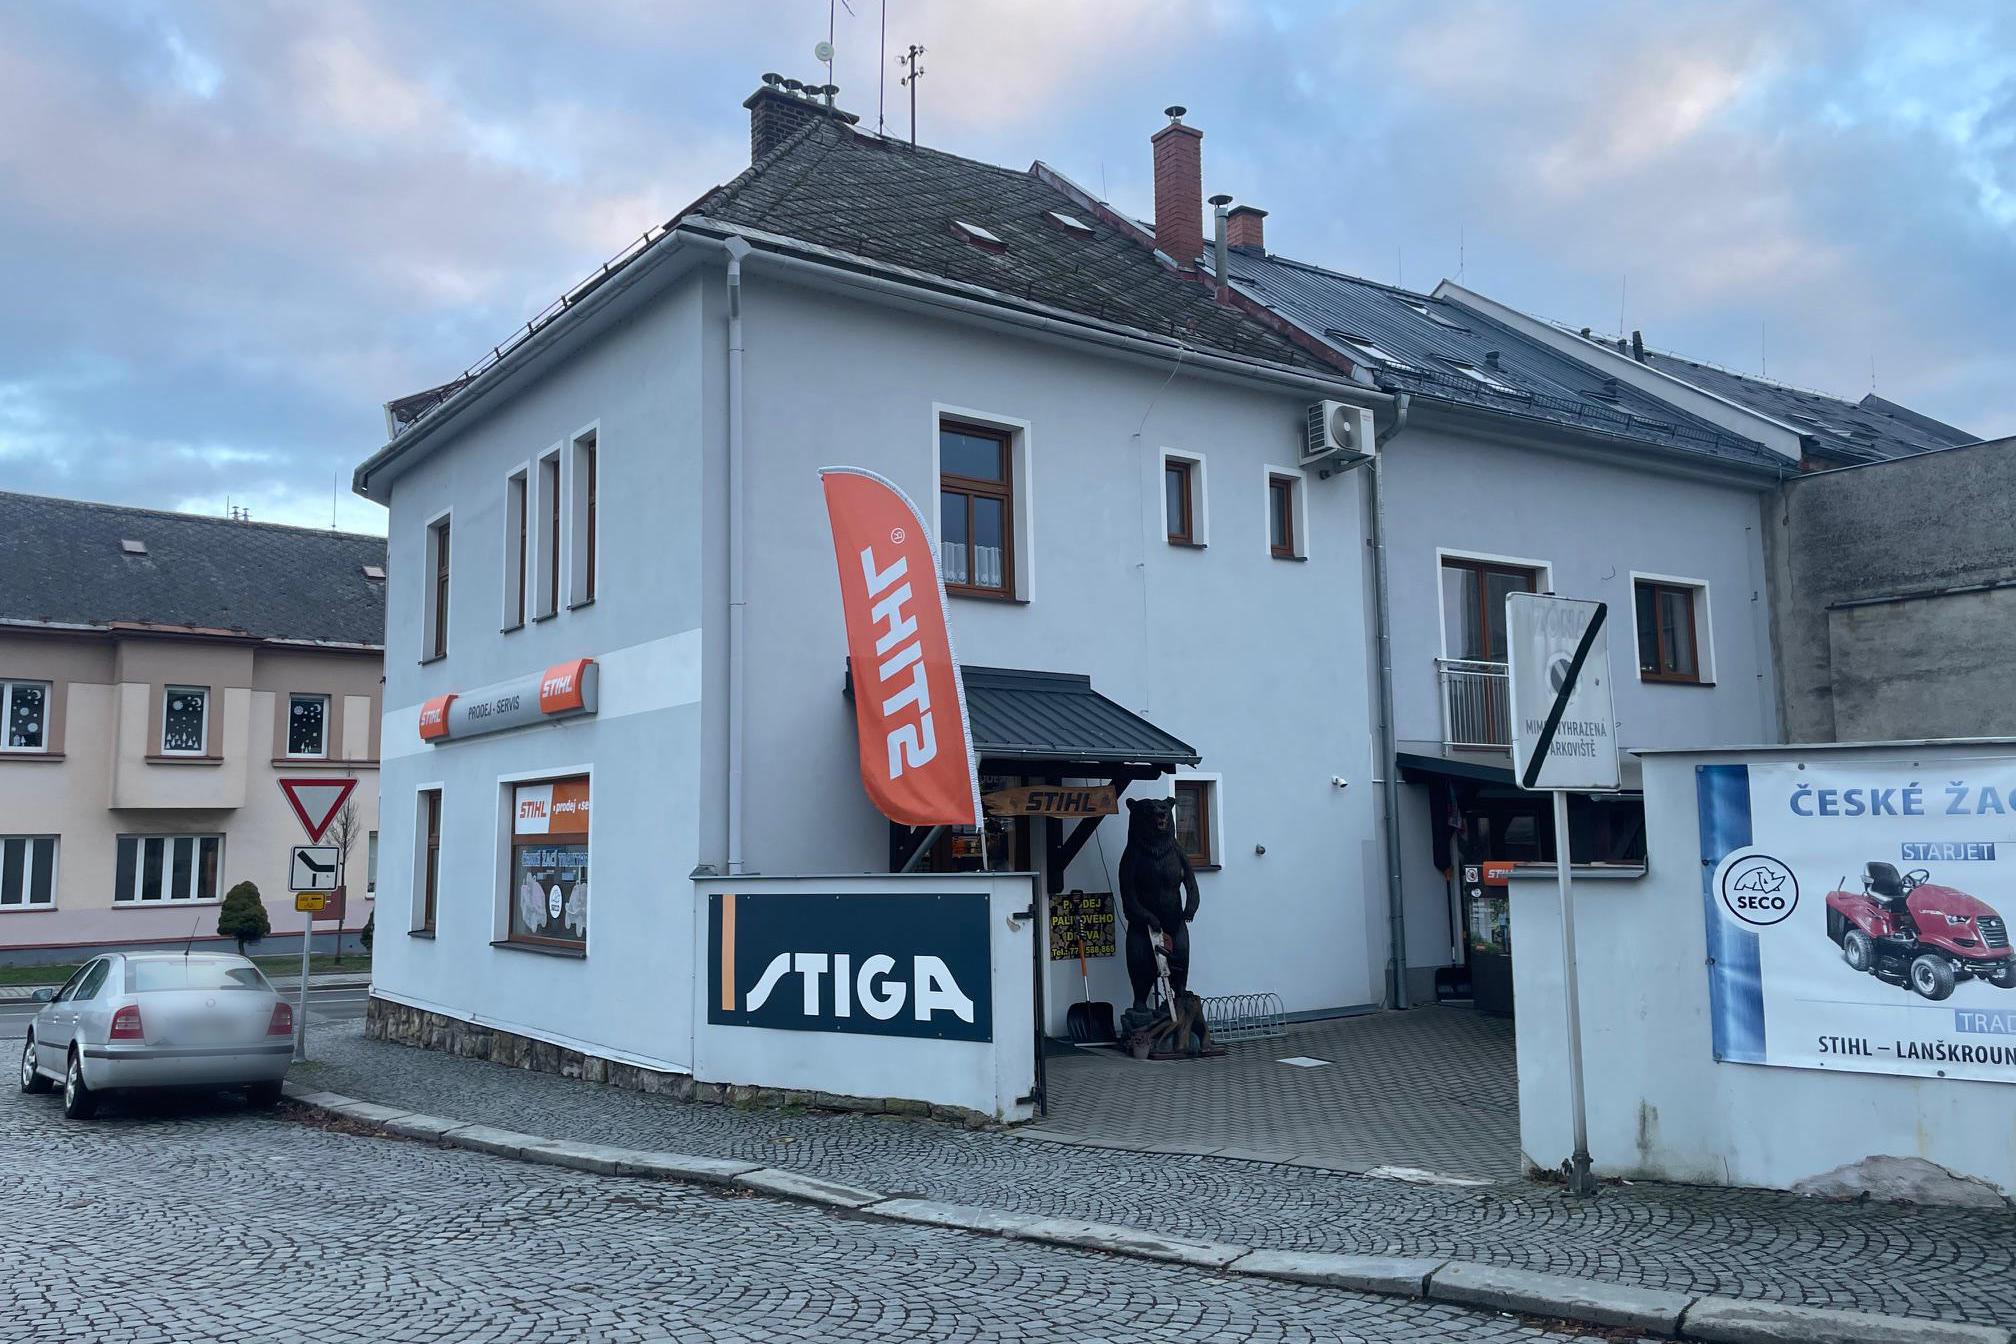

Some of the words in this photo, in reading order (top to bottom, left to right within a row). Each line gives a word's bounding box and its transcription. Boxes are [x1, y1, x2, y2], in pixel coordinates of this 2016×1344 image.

[543, 675, 572, 698] STIHL
[420, 708, 441, 726] STIHL
[468, 703, 492, 721] PRODEJ
[496, 695, 520, 714] SERVIS
[1550, 738, 1596, 757] ARKOVIŠTĚ
[520, 800, 547, 819] STIHL
[1025, 791, 1097, 812] STIHL
[1790, 782, 1925, 817] ČESKÉ
[1902, 842, 1993, 860] STARJET
[1737, 895, 1786, 910] SECO
[746, 952, 974, 1024] STIGA
[1818, 1035, 1873, 1057] STIHL
[1896, 1039, 2016, 1066] LANŠKROUN
